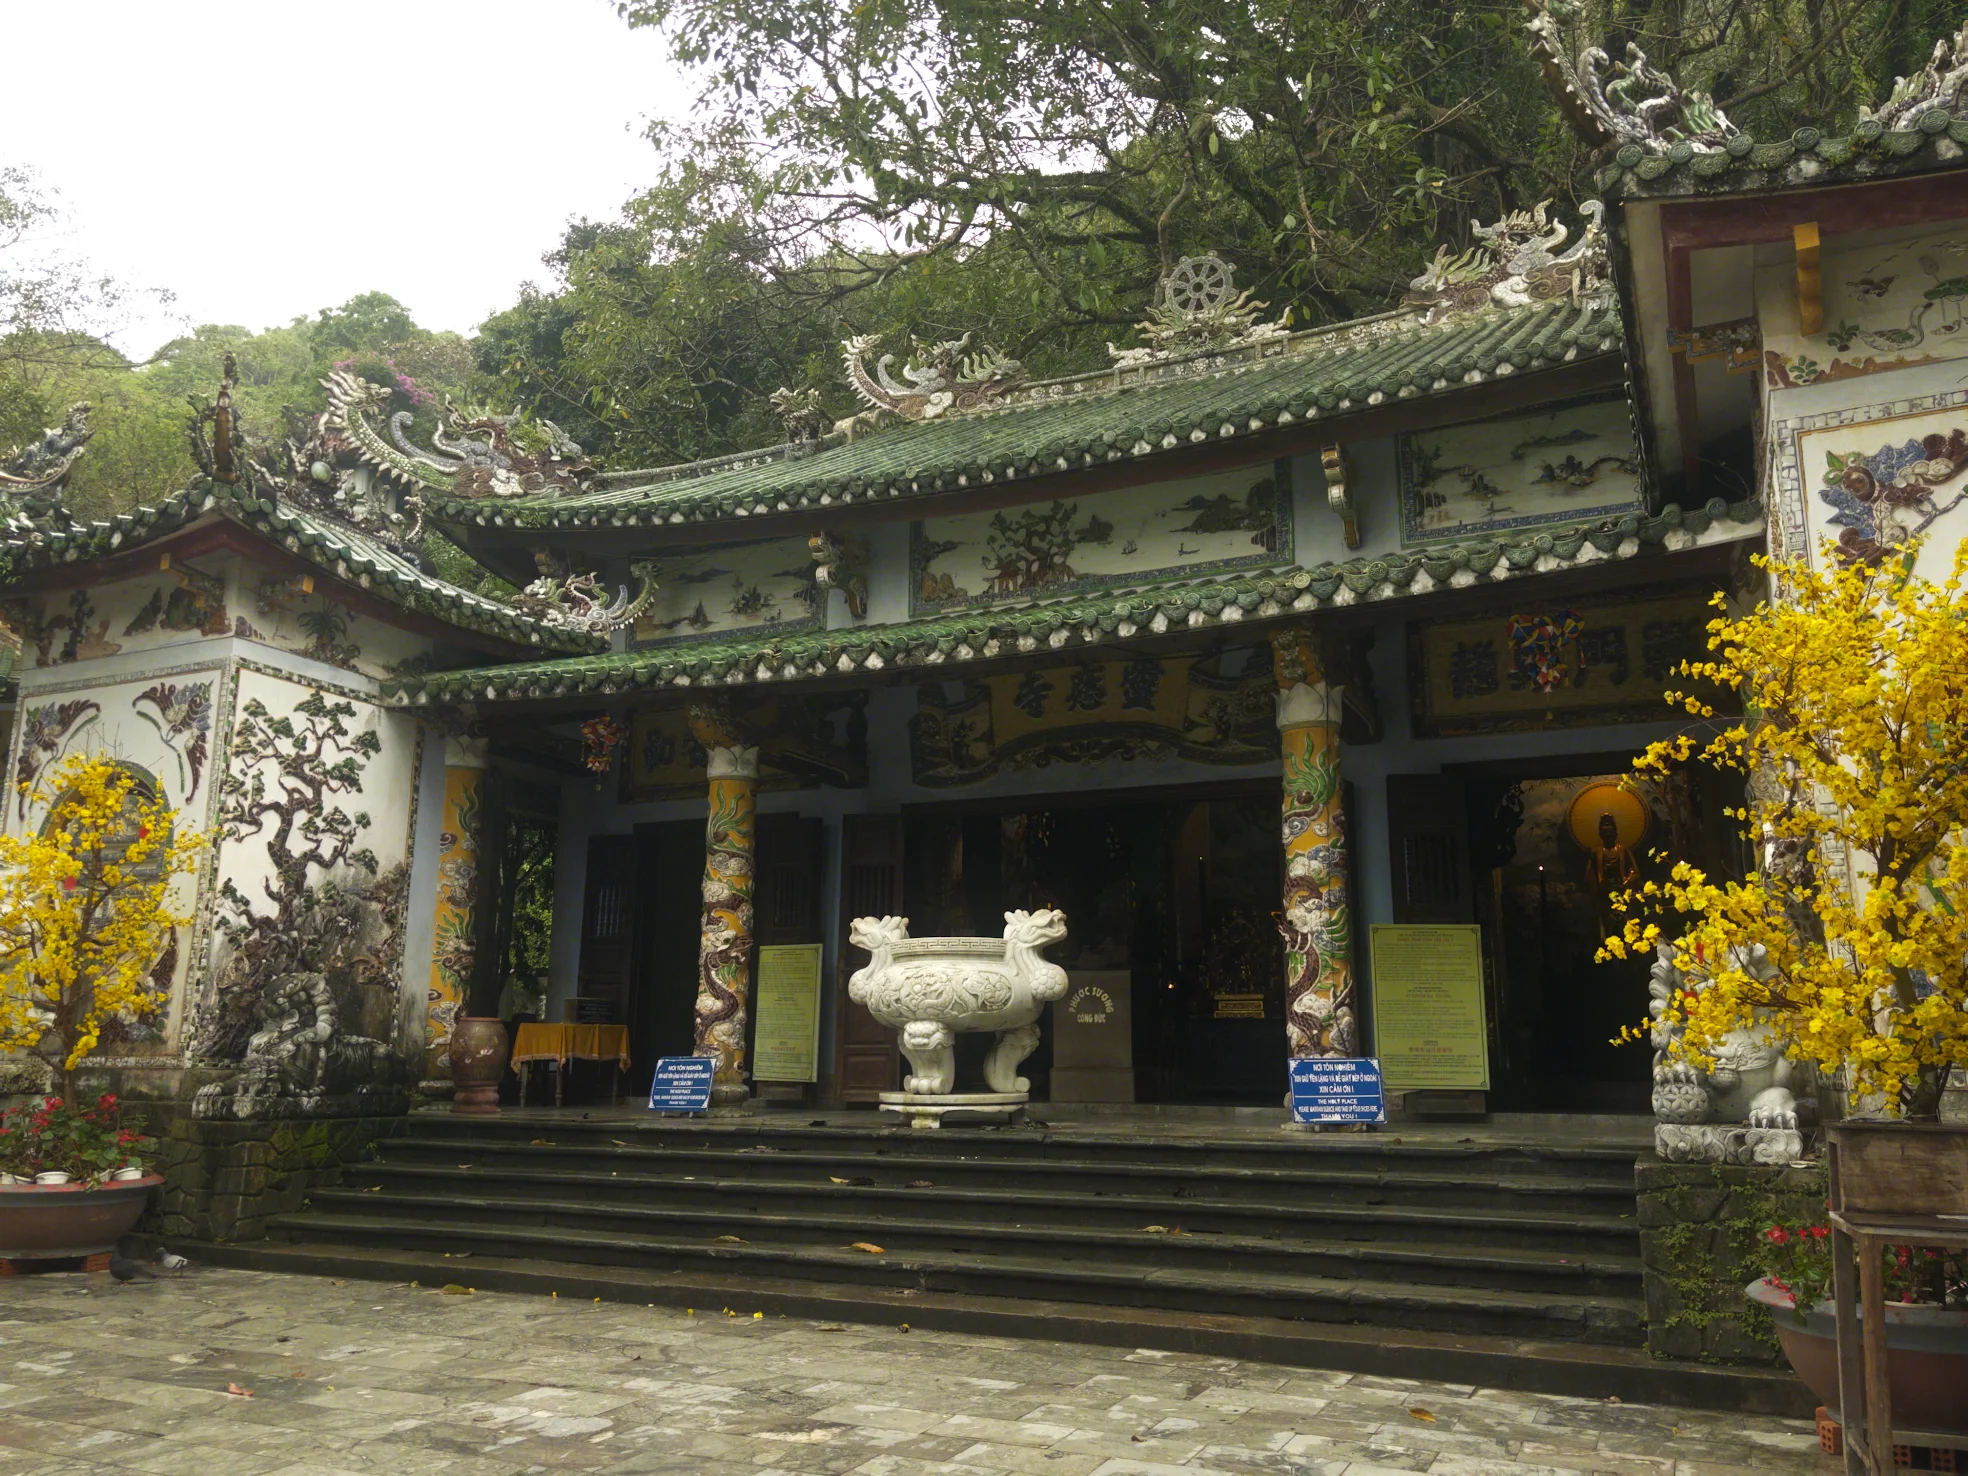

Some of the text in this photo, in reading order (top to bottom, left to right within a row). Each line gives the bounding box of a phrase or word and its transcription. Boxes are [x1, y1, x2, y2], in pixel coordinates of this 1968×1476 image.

[1068, 986, 1114, 1012] PHƯỚC SƯƠNG
[1077, 1012, 1106, 1023] CÔNG ĐỨC
[1314, 1062, 1356, 1071] NƠI TÔN NGHIÊM
[1329, 1083, 1342, 1093] CẢM
